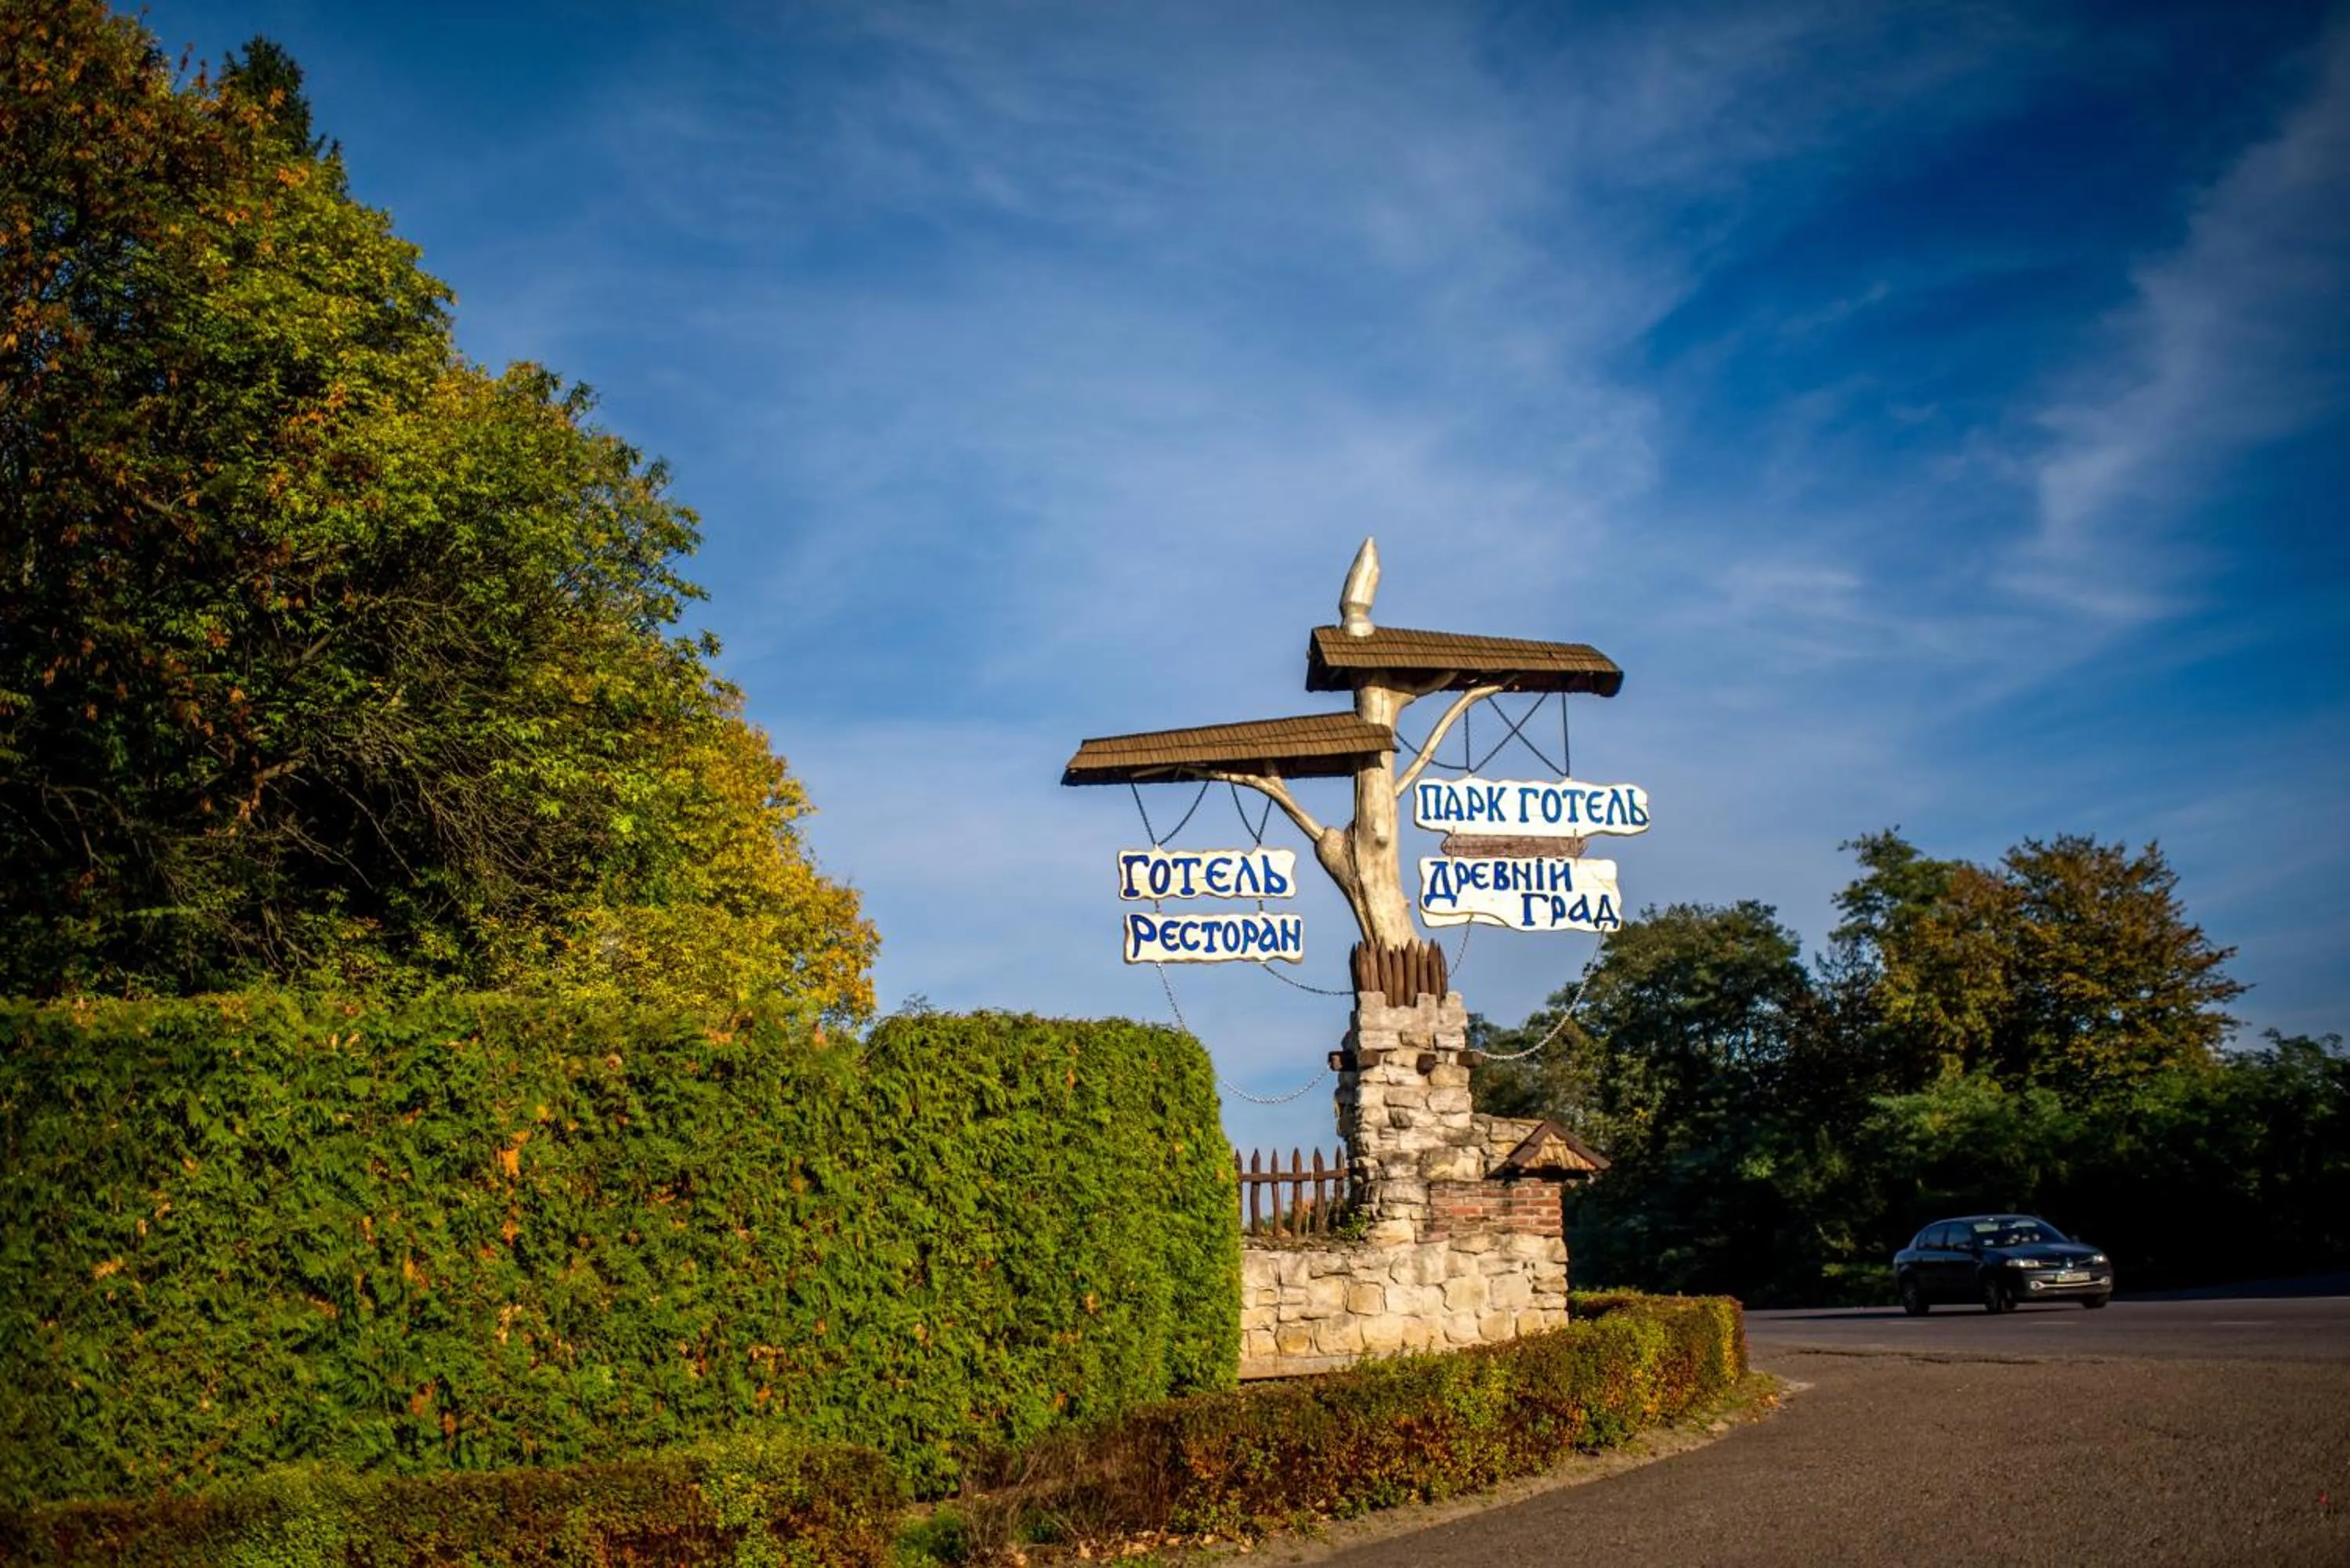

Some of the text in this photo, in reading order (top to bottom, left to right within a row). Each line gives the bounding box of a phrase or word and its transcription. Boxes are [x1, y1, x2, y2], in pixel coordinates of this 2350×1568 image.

[1419, 784, 1650, 826] ПАРК ГОТЕЛЬ
[1122, 854, 1288, 897] ГОТЕЛЬ
[1520, 892, 1620, 929] ГРАД
[1130, 914, 1301, 958] РЕСТОРАН
